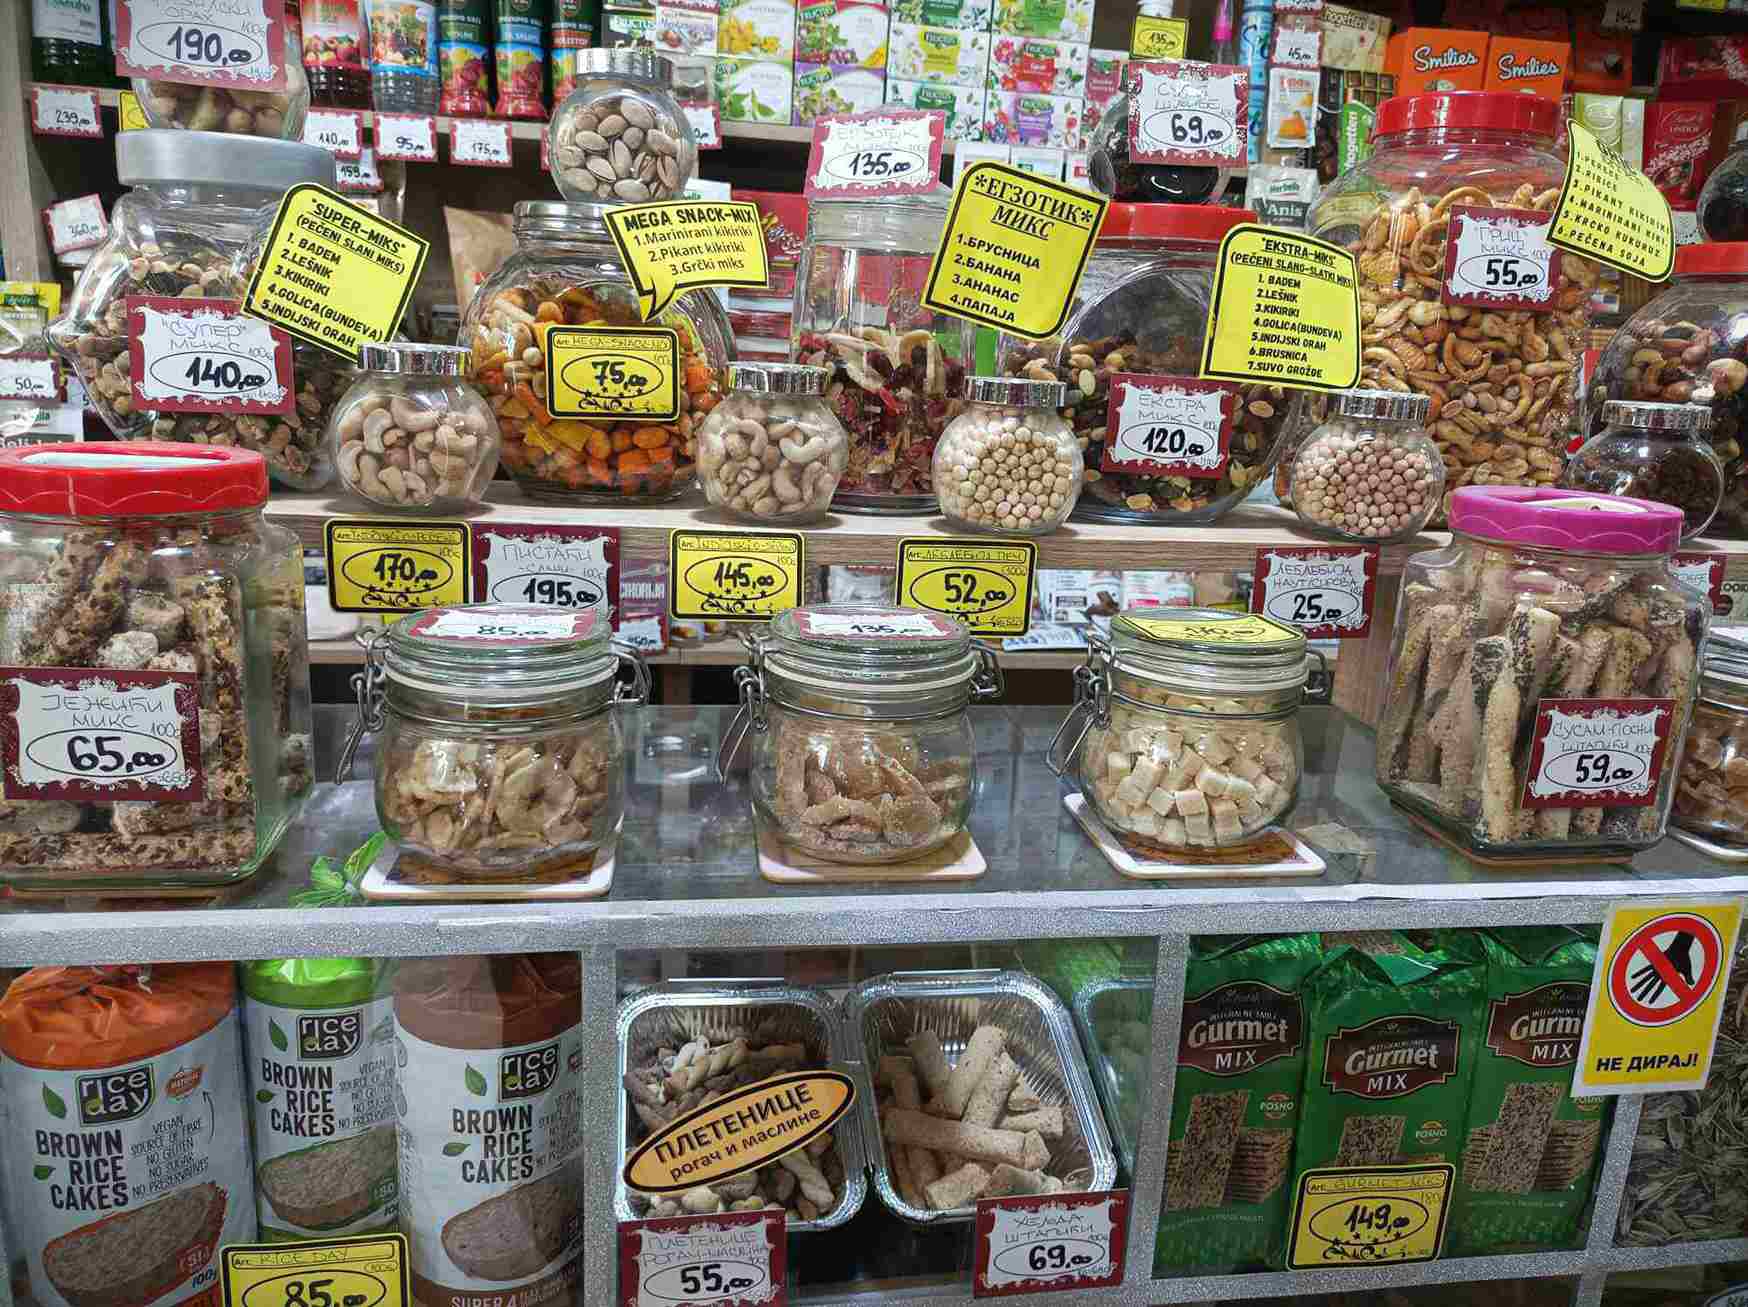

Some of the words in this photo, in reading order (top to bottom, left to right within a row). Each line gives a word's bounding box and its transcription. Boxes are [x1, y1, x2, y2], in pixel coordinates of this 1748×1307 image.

[1413, 46, 1479, 71] Smilies
[1498, 54, 1560, 80] Smilies
[848, 151, 912, 177] 135,00
[623, 210, 673, 232] MEGA
[675, 207, 755, 225] SNACK-MIX
[991, 205, 1056, 238] МИКС
[1266, 203, 1303, 219] Anis
[633, 231, 713, 247] 1.Marinirani
[713, 225, 753, 240] kikiriki
[280, 248, 335, 281] 2.LEŠNIK
[298, 238, 342, 265] BADEM
[344, 238, 375, 262] SLANI
[375, 255, 406, 276] MIKS)
[648, 246, 704, 263] 2.Pikant
[704, 240, 746, 256] kikiriki
[957, 233, 1041, 269] 1.БРУСНИЦА
[1619, 248, 1646, 267] SOJA
[670, 258, 716, 276] 3.Grčki
[717, 256, 745, 271] miks
[953, 253, 1022, 283] 2.БАНАНА
[1486, 258, 1538, 287] 55,00
[273, 264, 331, 298] 3.KIKIRIKI
[951, 273, 1020, 303] 3.АНАНАС
[1267, 275, 1301, 289] BADEM
[949, 294, 1016, 322] 4.ПАПАЈА
[1255, 302, 1300, 318] 3.KIKIRIKI
[1256, 288, 1299, 304] 2.LEŠNIK
[260, 299, 321, 333] 5.INDIJSKI
[321, 326, 358, 350] ORAH
[1248, 346, 1308, 363] 6.BRUSNICA
[1251, 331, 1301, 347] 5.INDIJSKI
[1302, 339, 1327, 351] ORAH
[185, 356, 266, 391] 140,00
[592, 360, 648, 390] 75,00
[1247, 360, 1284, 374] 7.SUVO
[1142, 427, 1204, 458] 120,00
[714, 561, 774, 590] 145,00
[943, 572, 1007, 607] 52,00
[522, 576, 597, 606] 195,00
[1292, 592, 1342, 622] 25,00
[72, 714, 138, 728] МИКС
[67, 735, 165, 773] 65,00
[1576, 754, 1633, 784] 59,00
[302, 1015, 357, 1040] rice
[1187, 1019, 1288, 1048] Gurmet
[1510, 1015, 1581, 1040] Gurm
[303, 1032, 357, 1053] day
[1532, 1043, 1574, 1060] MIX
[262, 1058, 333, 1089] BROWN
[504, 1048, 556, 1075] rice
[1215, 1050, 1257, 1070] MIX
[1345, 1044, 1439, 1075] Gurmet
[1596, 1057, 1623, 1072] НЕ
[1626, 1053, 1699, 1072] ДИРАЈ!
[80, 1071, 147, 1100] rice
[507, 1066, 558, 1092] day
[1367, 1073, 1408, 1092] MIX
[85, 1091, 148, 1115] day
[286, 1089, 334, 1114] RICE
[271, 1109, 336, 1137] CAKES
[452, 1104, 533, 1134] BROWN
[655, 1083, 813, 1163] ПЛЕТЕНИЦЕ
[36, 1129, 123, 1158] BROWN
[483, 1130, 533, 1158] RICE
[670, 1150, 722, 1182] рогач
[726, 1145, 737, 1157] и
[742, 1109, 821, 1150] маслине
[70, 1156, 125, 1185] RICE
[461, 1155, 534, 1184] CAKES
[51, 1183, 129, 1210] CAKES
[1344, 1204, 1410, 1232] 149,00
[1028, 1244, 1093, 1271] 69,00
[680, 1264, 753, 1295] 55,00
